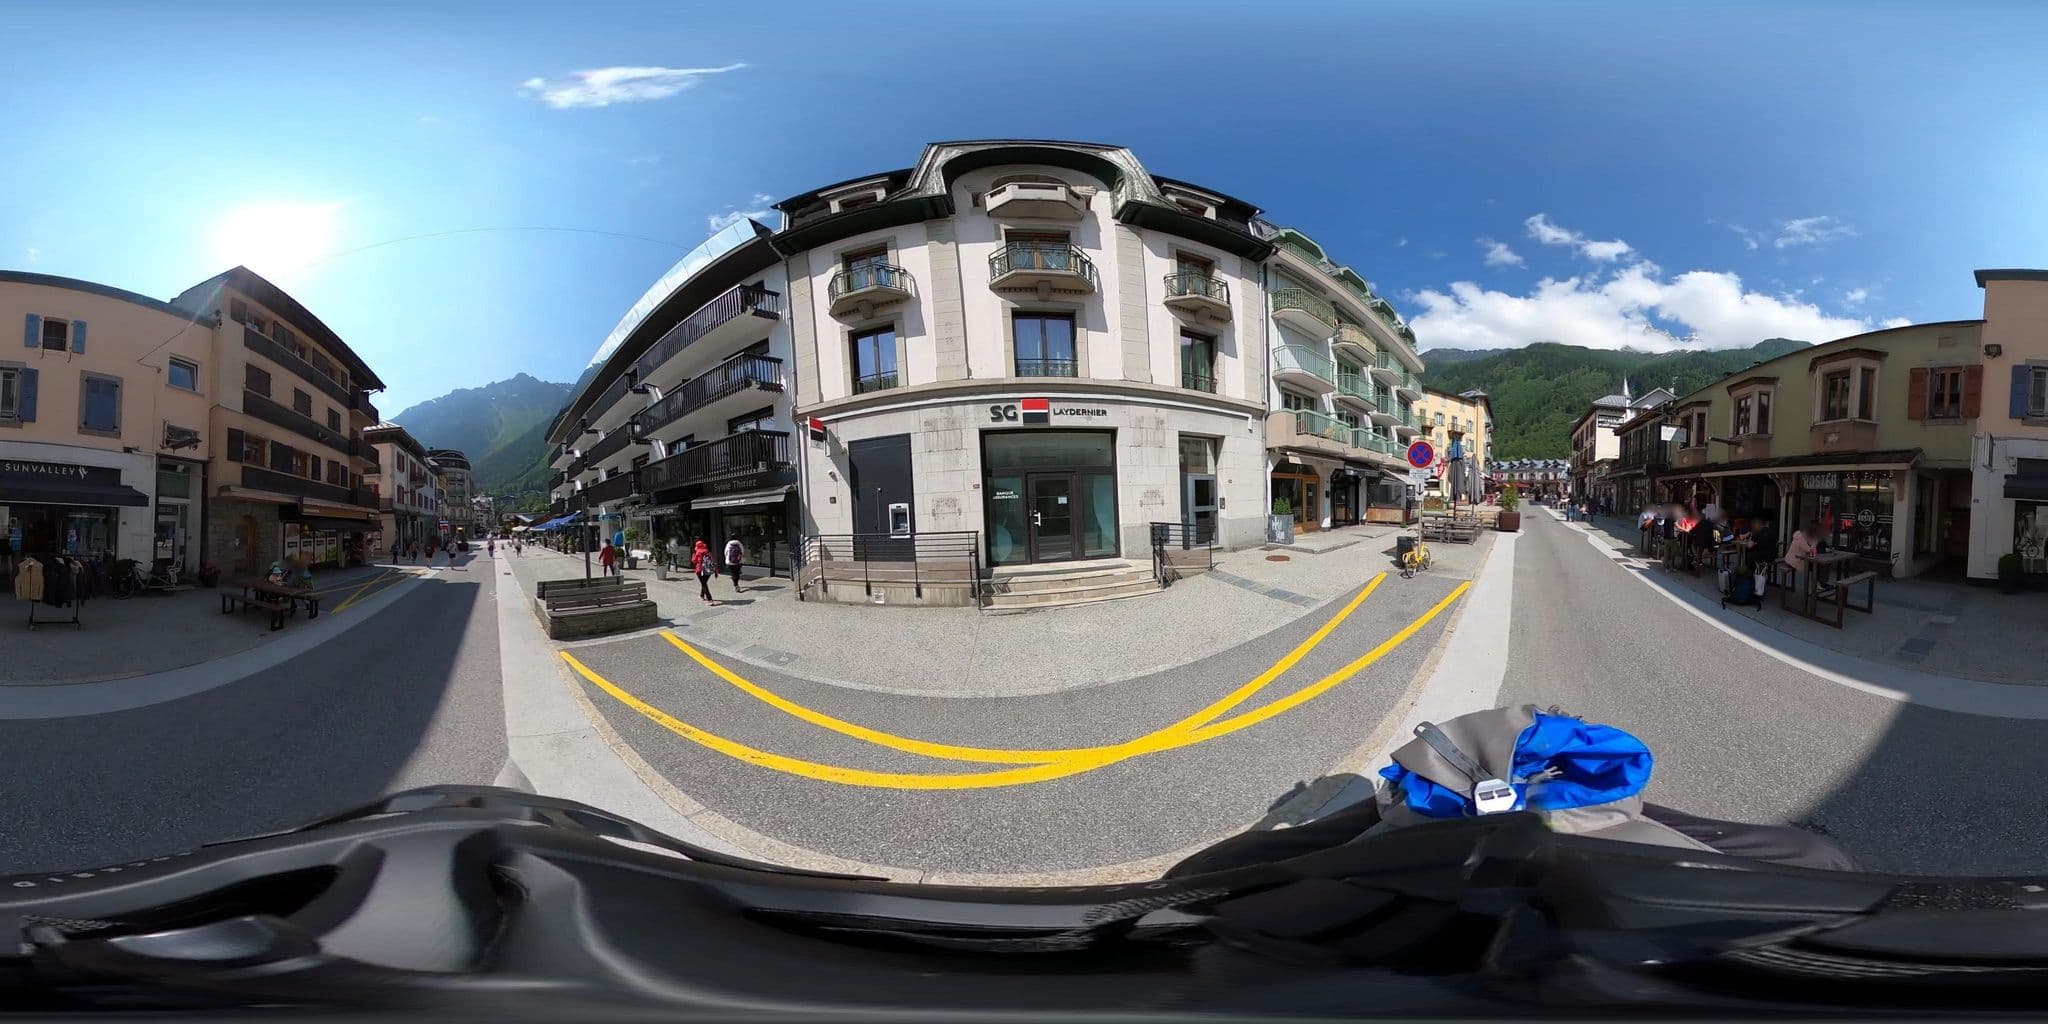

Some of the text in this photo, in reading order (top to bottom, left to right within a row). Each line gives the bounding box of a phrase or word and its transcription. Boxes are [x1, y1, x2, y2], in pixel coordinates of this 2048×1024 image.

[990, 405, 1107, 422] SG LAYDERNIER
[5, 463, 76, 476] SUNVALLEY
